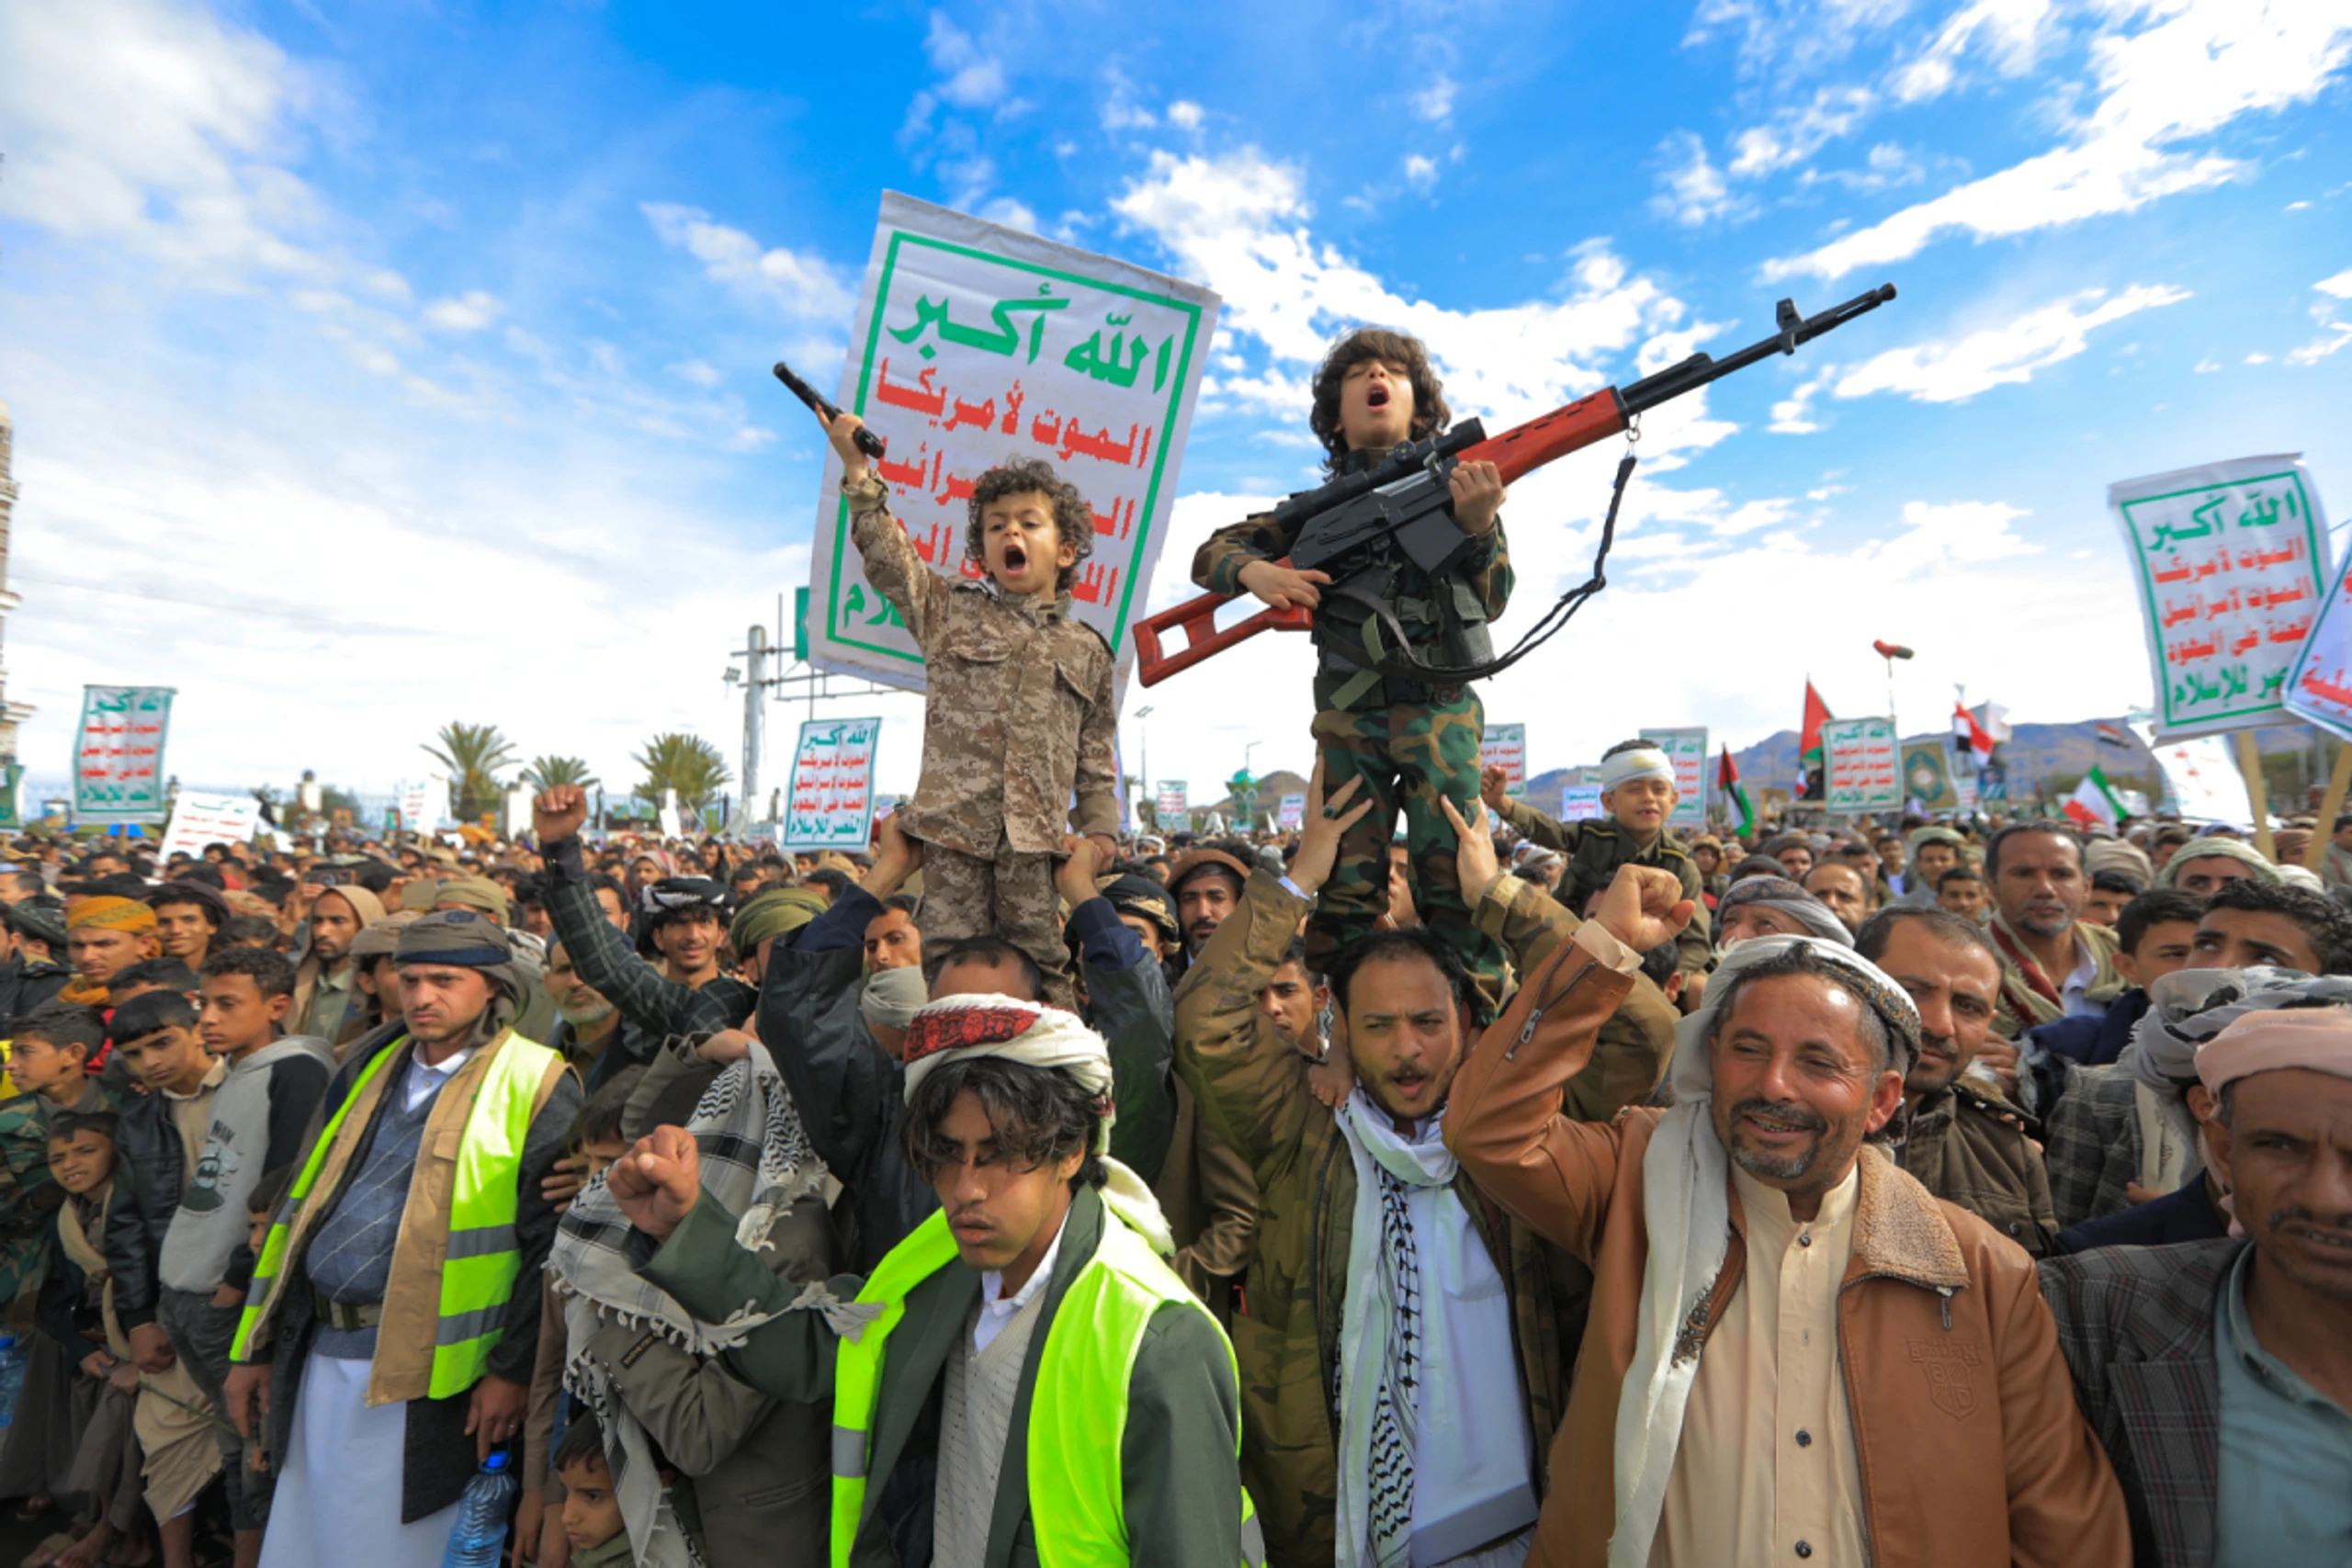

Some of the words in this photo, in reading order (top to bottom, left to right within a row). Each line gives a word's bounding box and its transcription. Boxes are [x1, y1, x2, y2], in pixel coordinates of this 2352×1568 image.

[886, 282, 1071, 365] أكبر
[1064, 313, 1173, 394] الله
[876, 356, 1024, 436] لأمريكا
[1030, 407, 1153, 468] الموت
